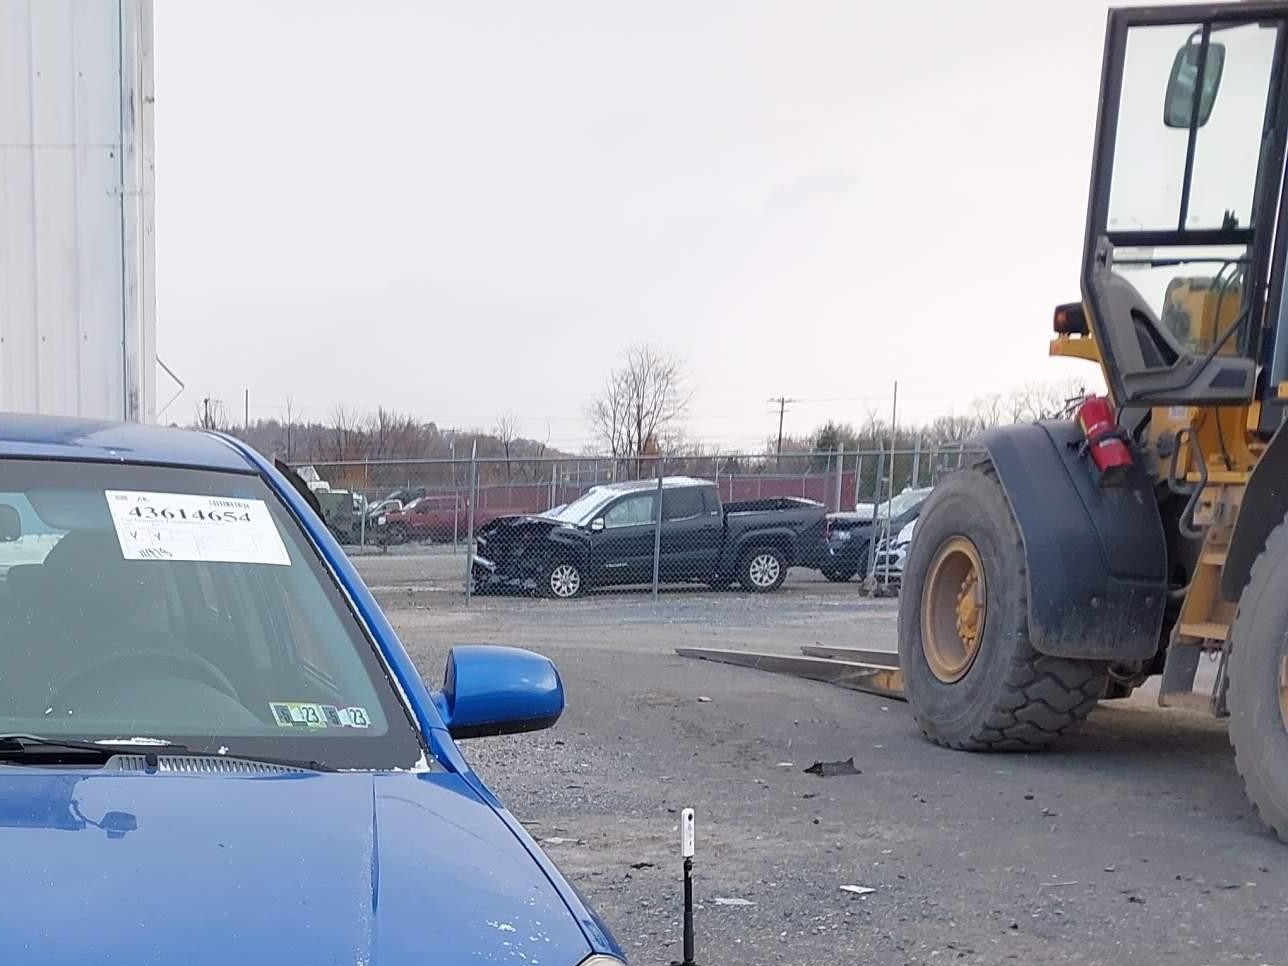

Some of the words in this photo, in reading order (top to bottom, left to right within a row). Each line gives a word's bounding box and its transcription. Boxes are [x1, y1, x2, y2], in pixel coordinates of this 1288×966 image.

[129, 506, 251, 523] 43614654
[301, 706, 320, 724] 23
[349, 708, 367, 726] 23
